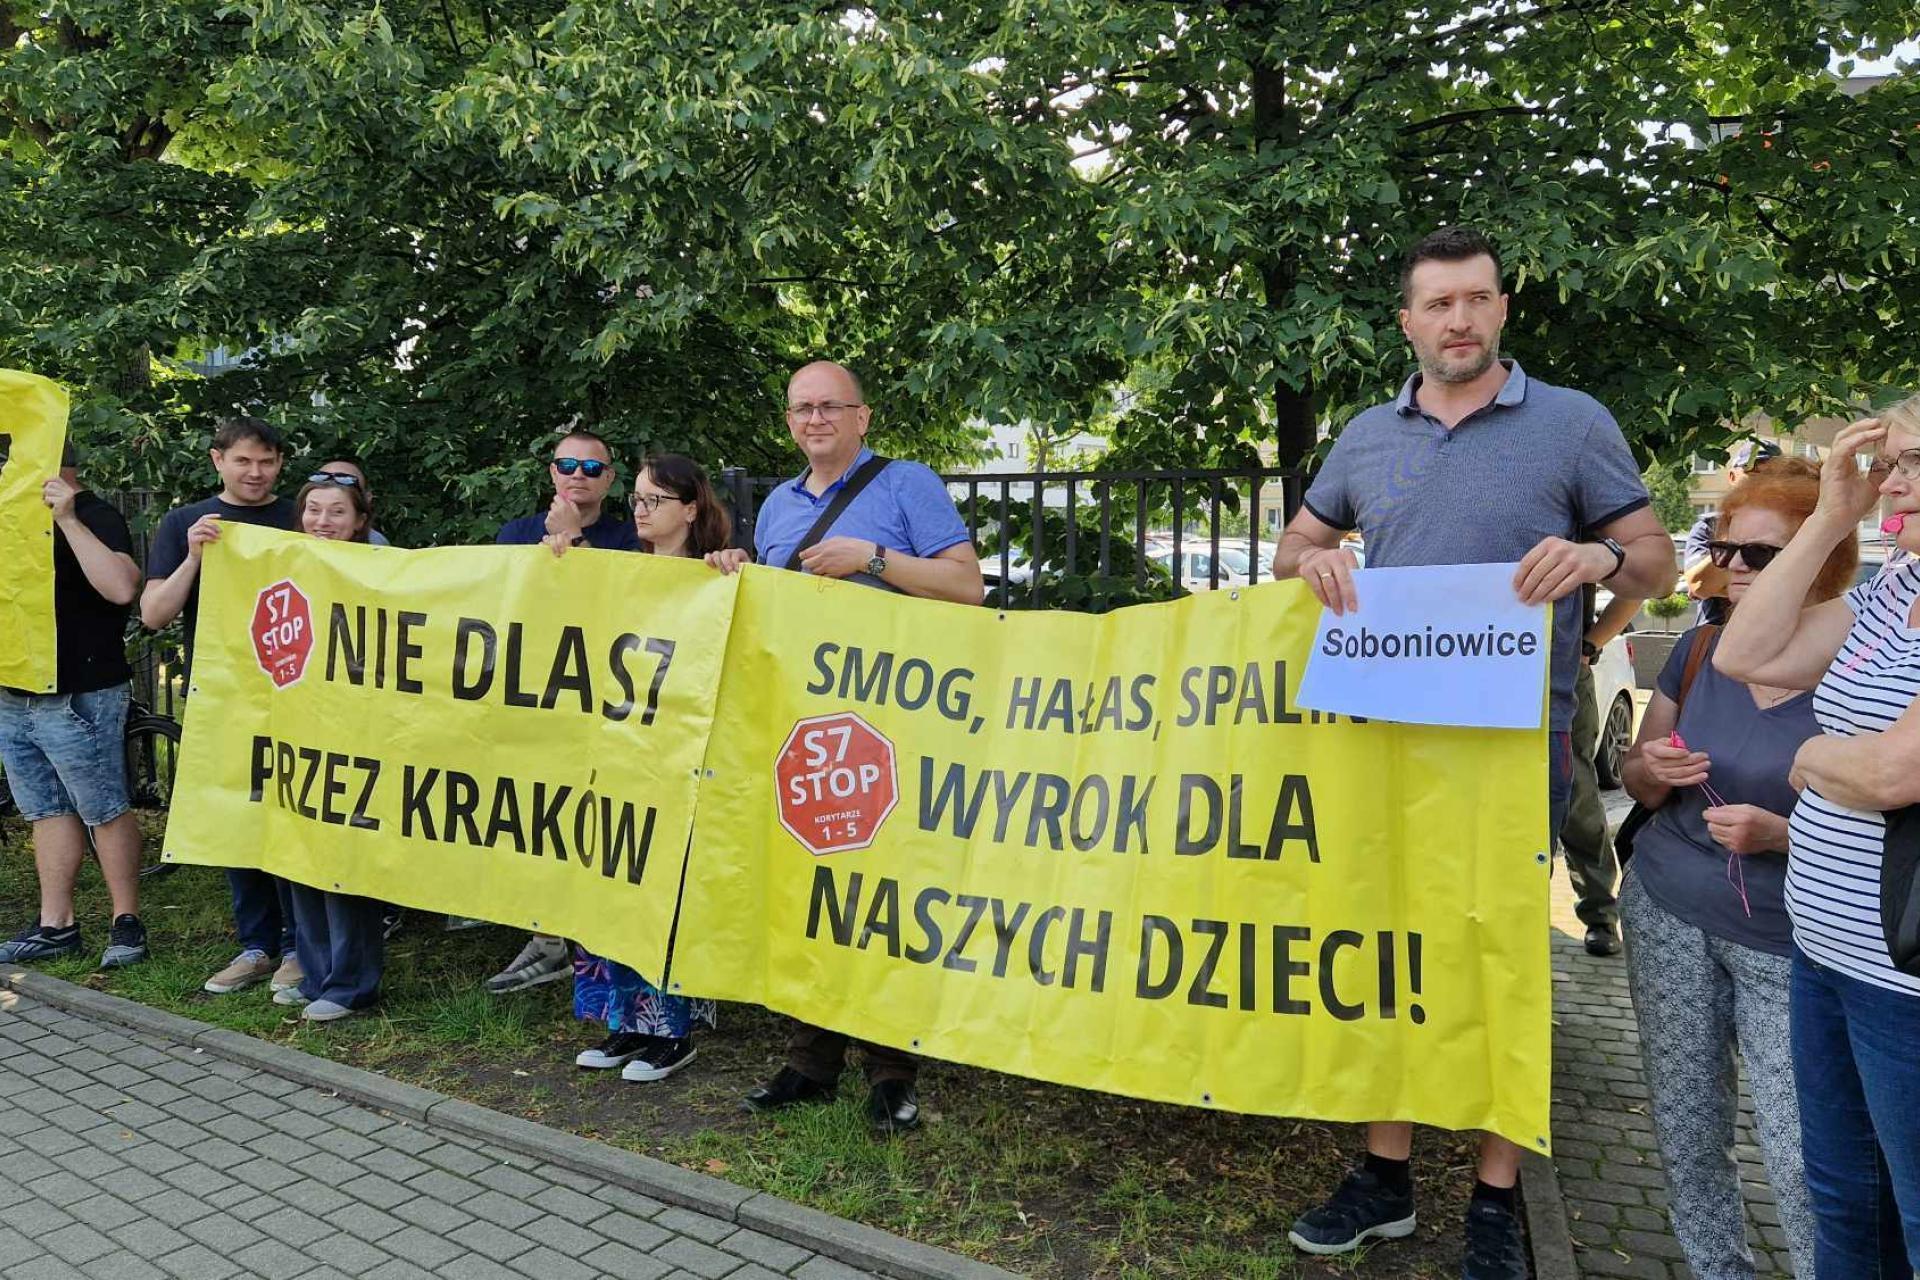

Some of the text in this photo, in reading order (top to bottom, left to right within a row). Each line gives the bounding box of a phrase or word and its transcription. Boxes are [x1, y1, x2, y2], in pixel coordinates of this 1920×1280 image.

[266, 588, 291, 624] S7
[262, 616, 304, 656] STOP
[1321, 624, 1537, 659] Soboniowice
[325, 602, 676, 727] NIE DLA S7
[806, 642, 1397, 741] SMOG, HAŁAS, SPAL
[804, 725, 852, 767] S7
[790, 764, 880, 806] STOP
[249, 735, 657, 886] PRZEZ KRAKÓW
[814, 809, 862, 823] KORYTARZE
[918, 756, 1321, 864] WYROK DLA
[805, 864, 1427, 1025] NASZYCH DZIECI!
